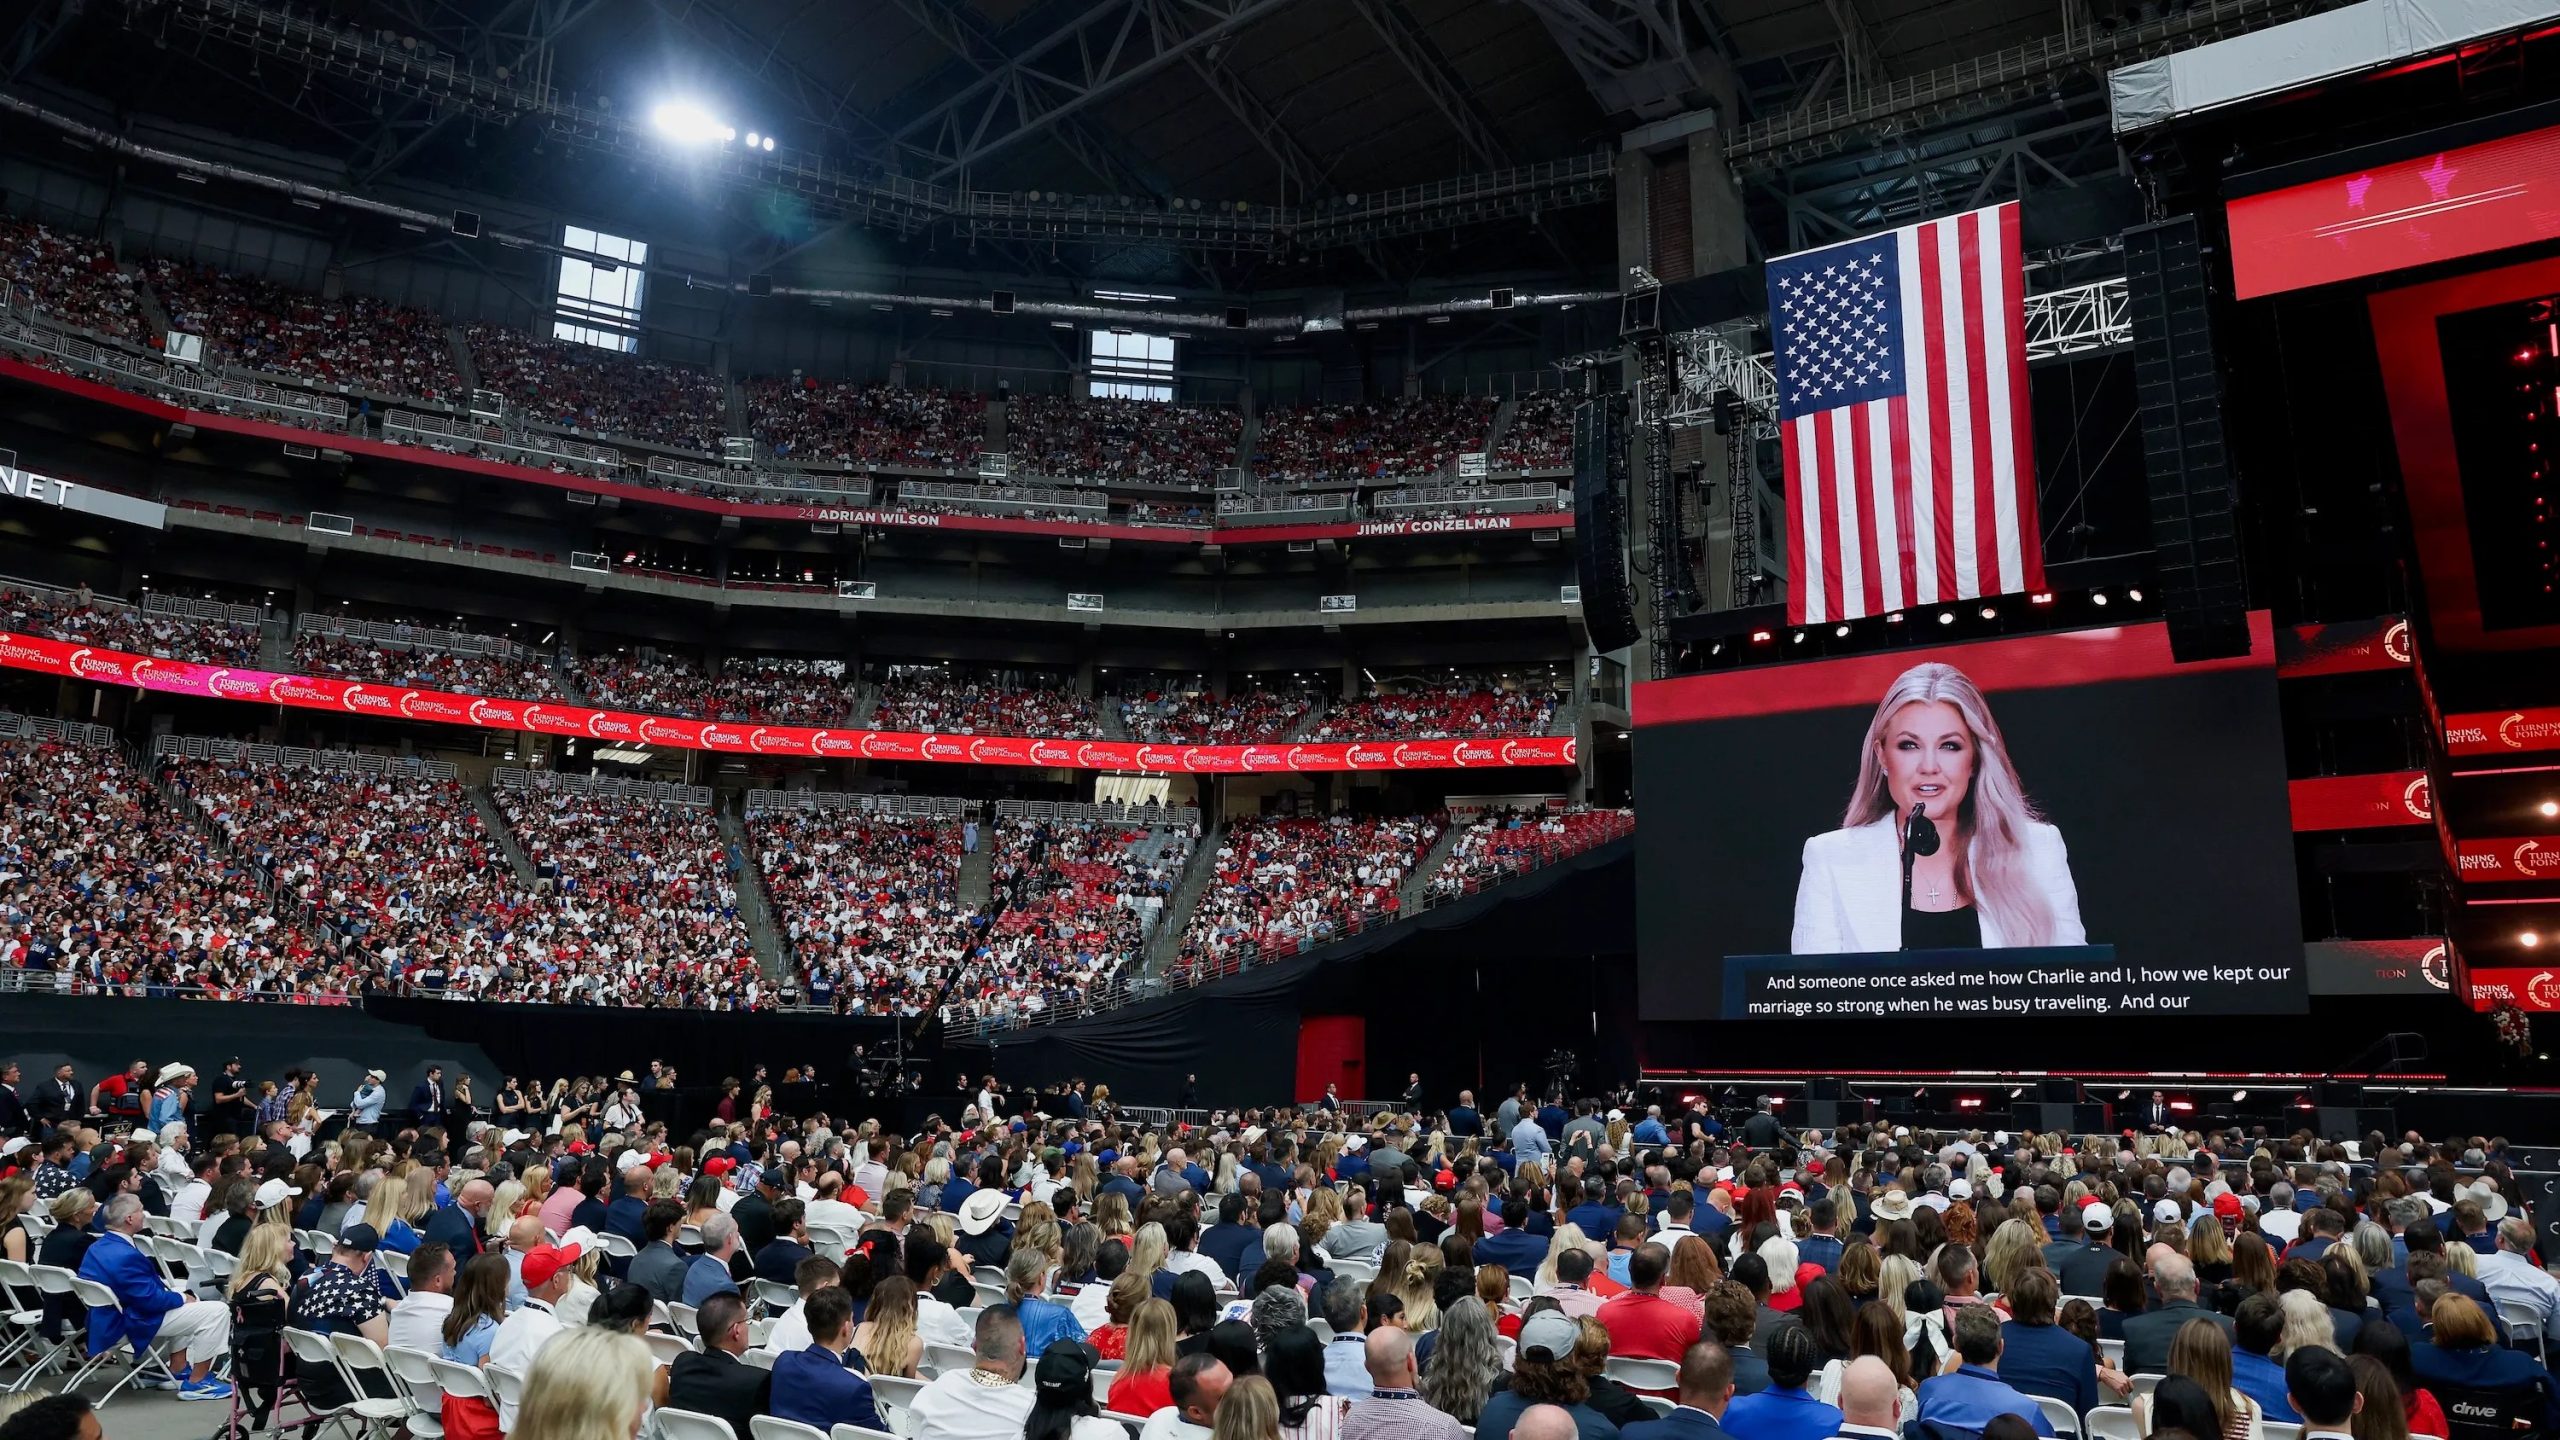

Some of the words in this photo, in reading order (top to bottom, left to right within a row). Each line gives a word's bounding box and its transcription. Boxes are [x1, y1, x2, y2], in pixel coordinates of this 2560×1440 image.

[0, 465, 74, 505] NET
[797, 508, 814, 518] 24
[818, 509, 876, 522] ADRIAN
[880, 513, 940, 526] WILSON
[1356, 522, 1406, 535] JIMMY
[1411, 517, 1511, 532] CONZELMAN
[0, 645, 40, 656] TURNING
[0, 650, 28, 660] POINT
[29, 653, 60, 664] ACTION
[83, 658, 120, 669] TURNING
[81, 663, 106, 673] POINT
[108, 667, 122, 675] USA
[144, 669, 181, 679] TURNING
[143, 674, 169, 683] POINT
[170, 677, 199, 687] ACTION
[220, 679, 257, 688] TURNING
[220, 684, 244, 692] POINT
[245, 686, 260, 694] USA
[281, 686, 317, 694] TURNING
[280, 690, 305, 698] POINT
[306, 693, 334, 701] ACTION
[354, 694, 389, 702] TURNING
[353, 698, 377, 706] POINT
[378, 700, 391, 708] USA
[411, 700, 444, 709] TURNING
[410, 705, 434, 713] POINT
[435, 707, 461, 715] ACTION
[480, 708, 512, 716] TURNING
[534, 714, 565, 722] TURNING
[556, 720, 580, 728] ACTION
[599, 725, 620, 733] POINT
[649, 726, 678, 734] TURNING
[2516, 730, 2550, 738] POINT
[648, 730, 670, 738] POINT
[671, 733, 693, 741] ACTION
[2468, 734, 2488, 742] USA
[2483, 860, 2502, 869] USA
[1767, 976, 1795, 989] And
[1799, 977, 1866, 989] someone
[1870, 974, 1906, 987] once
[1910, 972, 1955, 987] asked
[1959, 973, 1985, 986] me
[1989, 971, 2023, 985] how
[2027, 968, 2085, 984] Charlie
[2090, 967, 2121, 983] and
[2127, 968, 2136, 984] I,
[2141, 966, 2178, 981] how
[2182, 968, 2208, 981] we
[2213, 965, 2254, 984] kept
[2258, 967, 2291, 980] our
[2495, 991, 2515, 999] USA
[1749, 1000, 1812, 1016] marriage
[1816, 1000, 1833, 1013] so
[1836, 1000, 1884, 1015] strong
[1887, 997, 1930, 1012] when
[1934, 996, 1953, 1011] he
[1957, 998, 1989, 1011] was
[1993, 996, 2030, 1014] busy
[2034, 994, 2111, 1013] traveling.
[2120, 994, 2154, 1009] And
[2160, 995, 2190, 1008] our
[2452, 1402, 2497, 1418] drive
